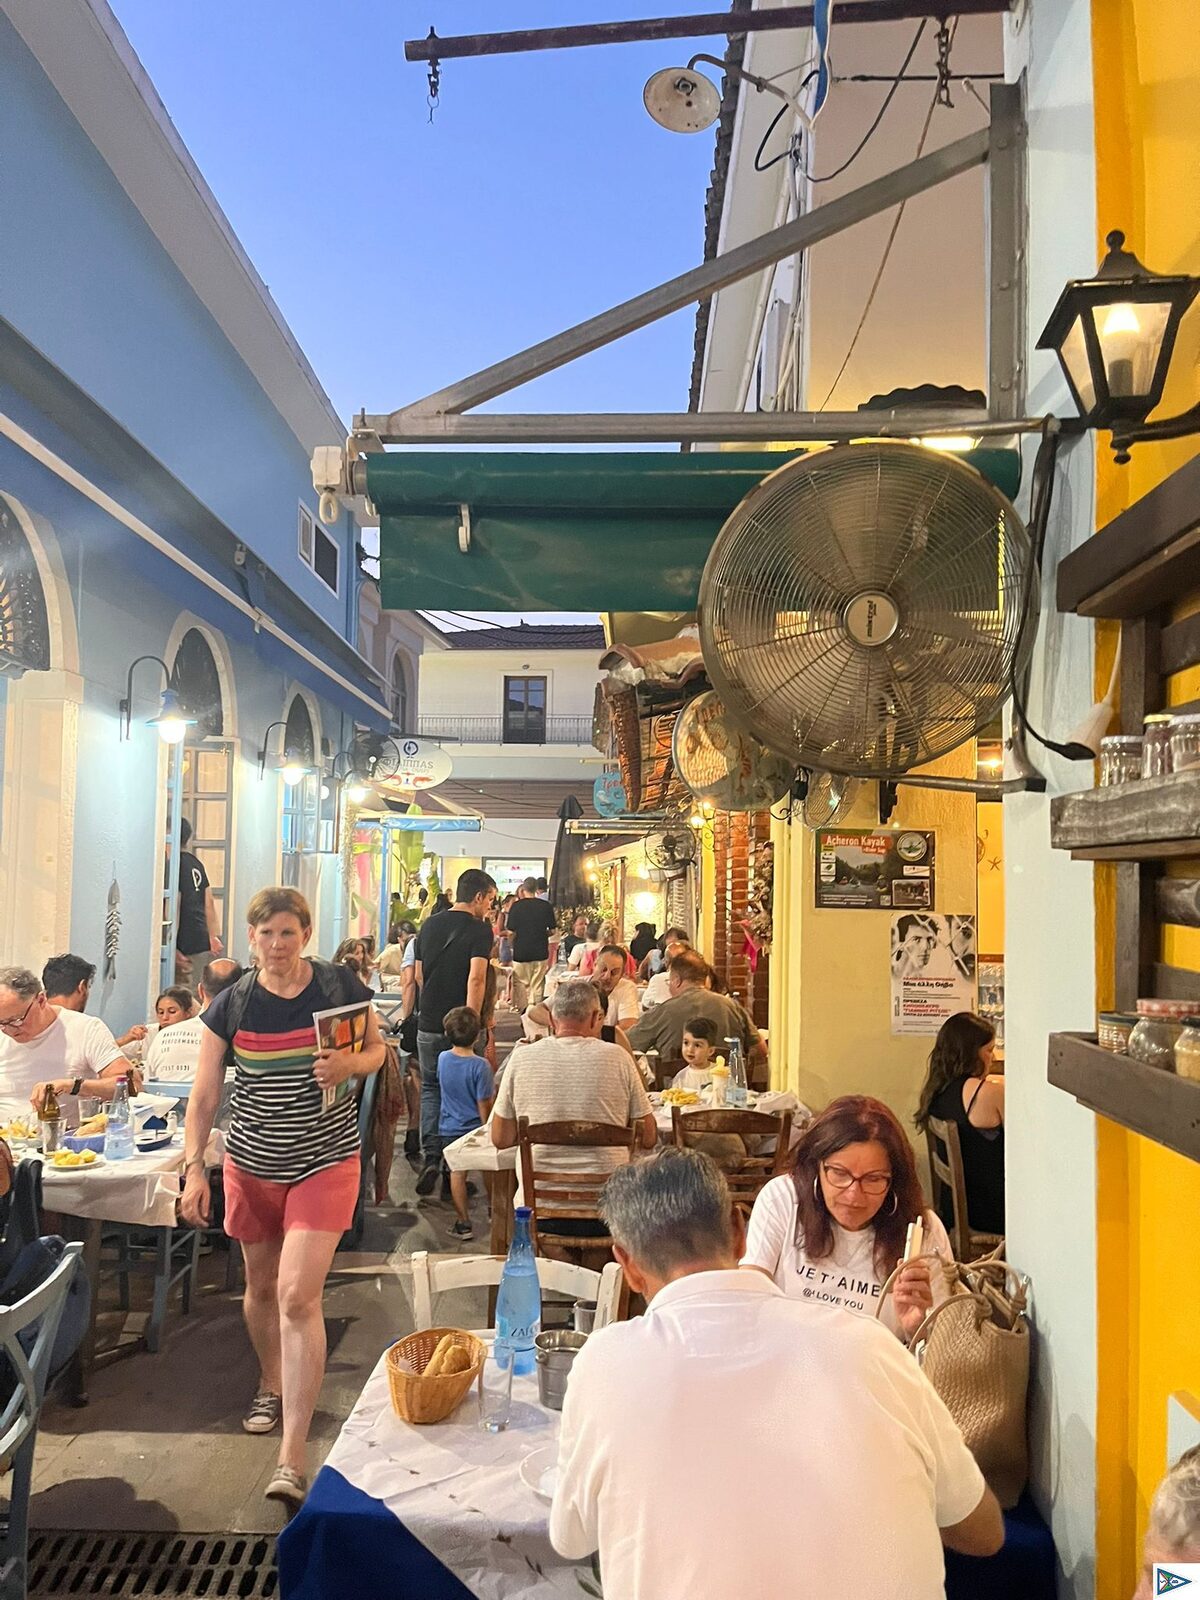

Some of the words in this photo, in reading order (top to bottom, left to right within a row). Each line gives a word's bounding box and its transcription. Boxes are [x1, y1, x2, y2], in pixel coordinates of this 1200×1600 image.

[826, 835, 859, 846] Acheron
[861, 836, 886, 848] Kayak
[796, 1265, 816, 1280] JE
[816, 1291, 842, 1305] LOVE
[844, 1299, 864, 1310] YOU
